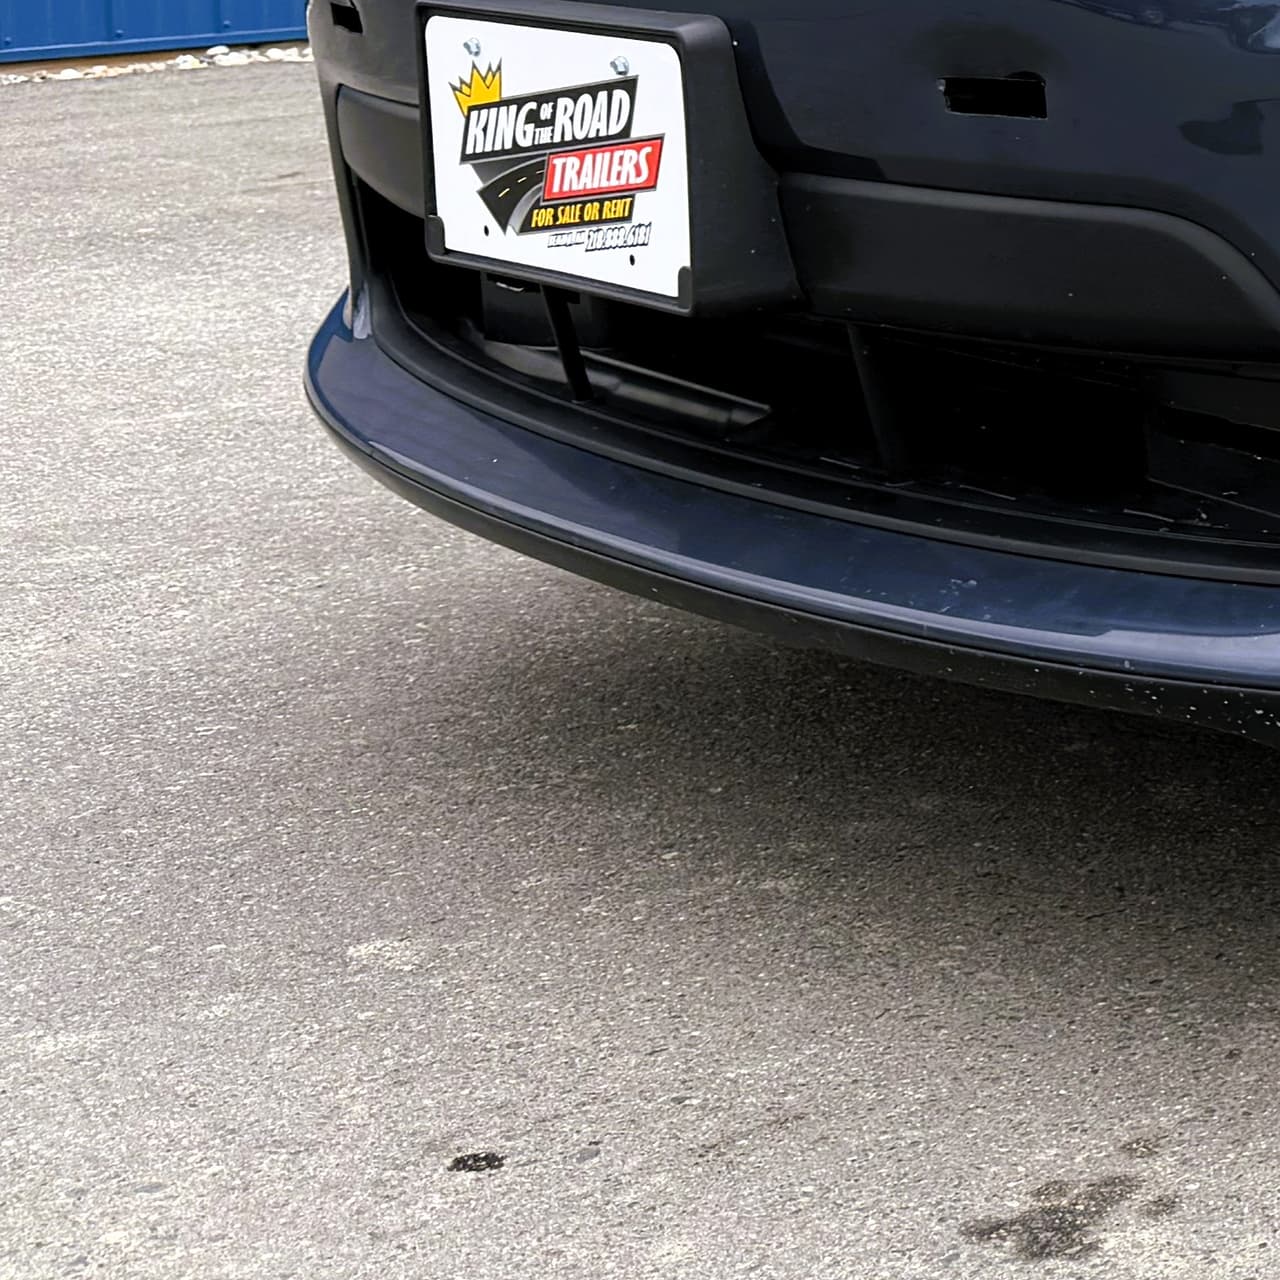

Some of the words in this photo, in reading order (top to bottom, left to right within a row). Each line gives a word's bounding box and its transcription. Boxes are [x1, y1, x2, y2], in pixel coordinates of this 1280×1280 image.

[465, 101, 537, 155] KING
[539, 102, 554, 120] OF
[553, 89, 631, 143] ROAD
[534, 126, 554, 146] THE
[552, 146, 652, 193] TRAILERS
[531, 208, 554, 227] FOR
[556, 204, 582, 225] SALE
[584, 202, 600, 221] OR
[602, 198, 633, 219] RENT
